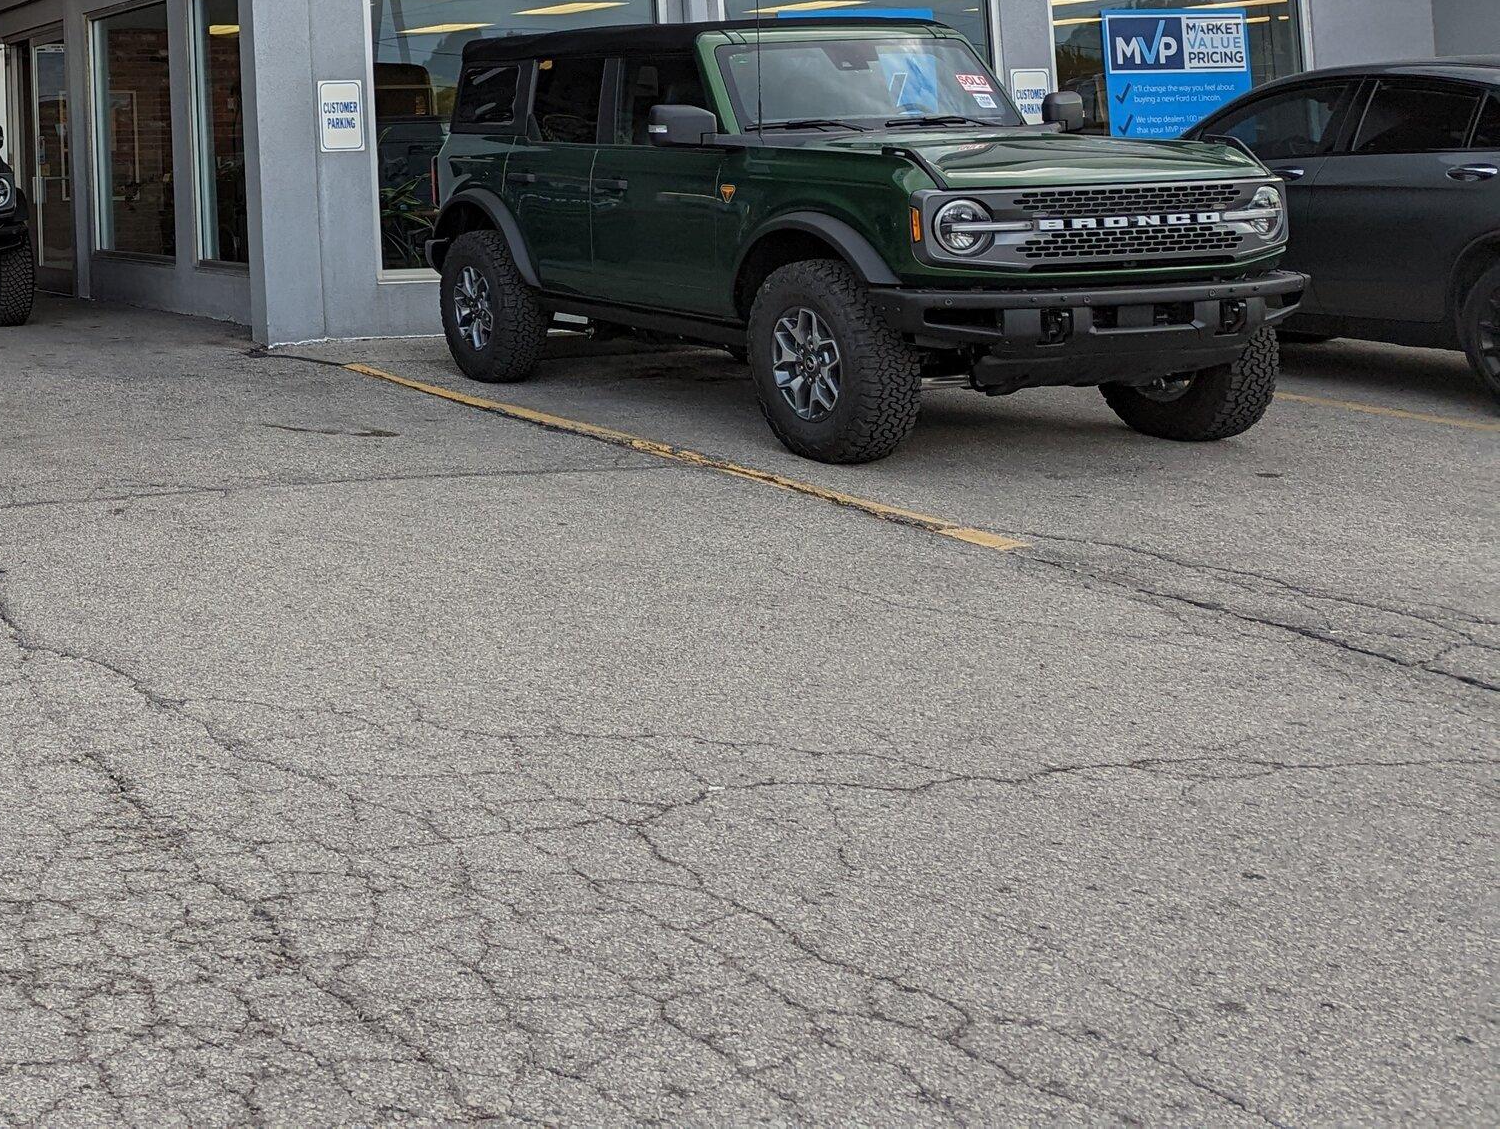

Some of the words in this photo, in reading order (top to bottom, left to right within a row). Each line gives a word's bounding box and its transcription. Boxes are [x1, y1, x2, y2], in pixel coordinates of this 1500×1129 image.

[1185, 23, 1241, 35] MARKET
[1115, 20, 1178, 65] MVP
[1186, 37, 1242, 49] VALUE
[1188, 51, 1243, 64] PRICING
[958, 75, 987, 86] SOLD
[1016, 89, 1046, 100] CUSTOMER
[1144, 85, 1166, 93] change
[1134, 96, 1155, 105] buying
[323, 102, 358, 114] CUSTOMER
[1020, 104, 1042, 114] PARKIN
[327, 117, 356, 129] PARKING
[1147, 116, 1162, 124] shop
[1163, 115, 1185, 123] dealers
[1039, 211, 1221, 231] BRONCO
